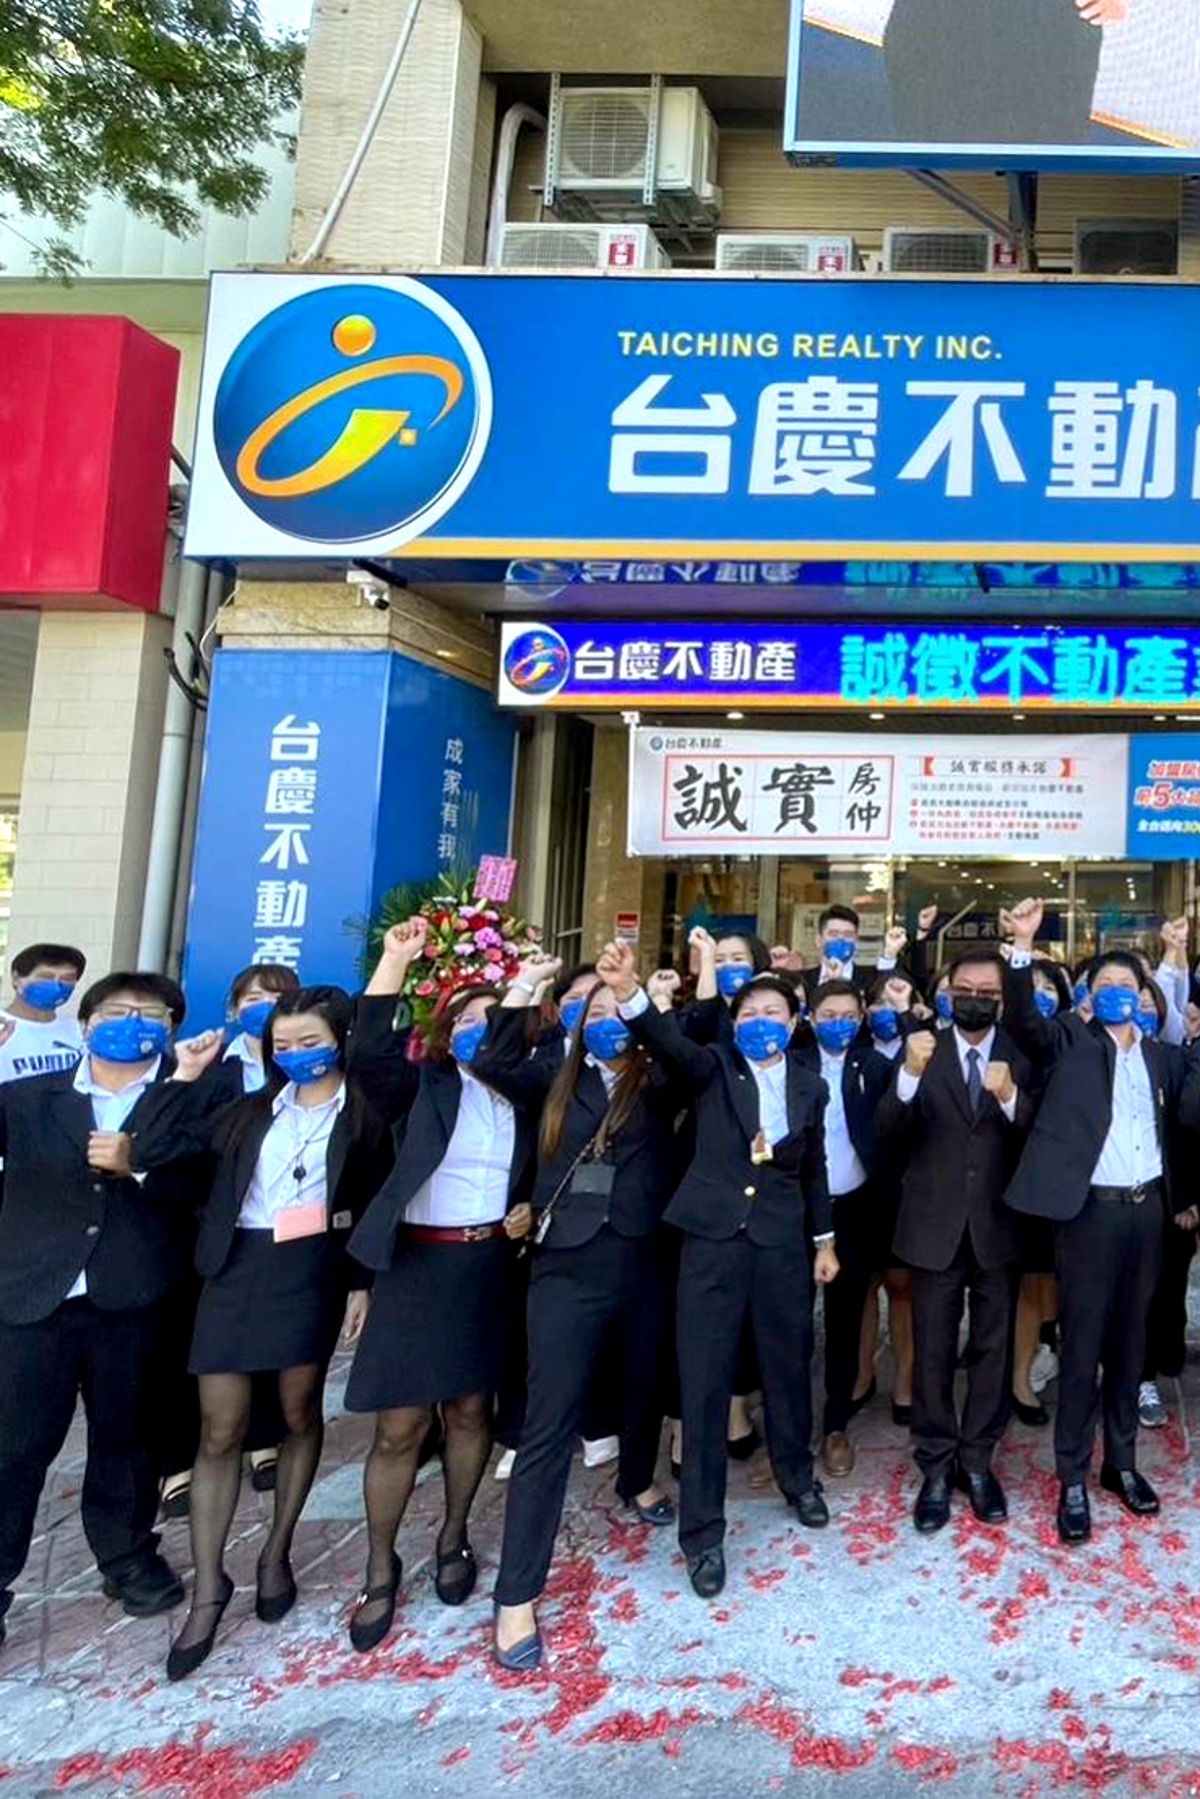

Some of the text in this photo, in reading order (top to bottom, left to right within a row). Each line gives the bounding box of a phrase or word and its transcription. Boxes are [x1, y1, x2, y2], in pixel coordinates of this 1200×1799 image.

[617, 331, 1003, 360] TAICHING REALTY INC.
[573, 640, 797, 682] 台慶不動產
[673, 762, 836, 833] 誠實
[845, 762, 882, 832] 房仲
